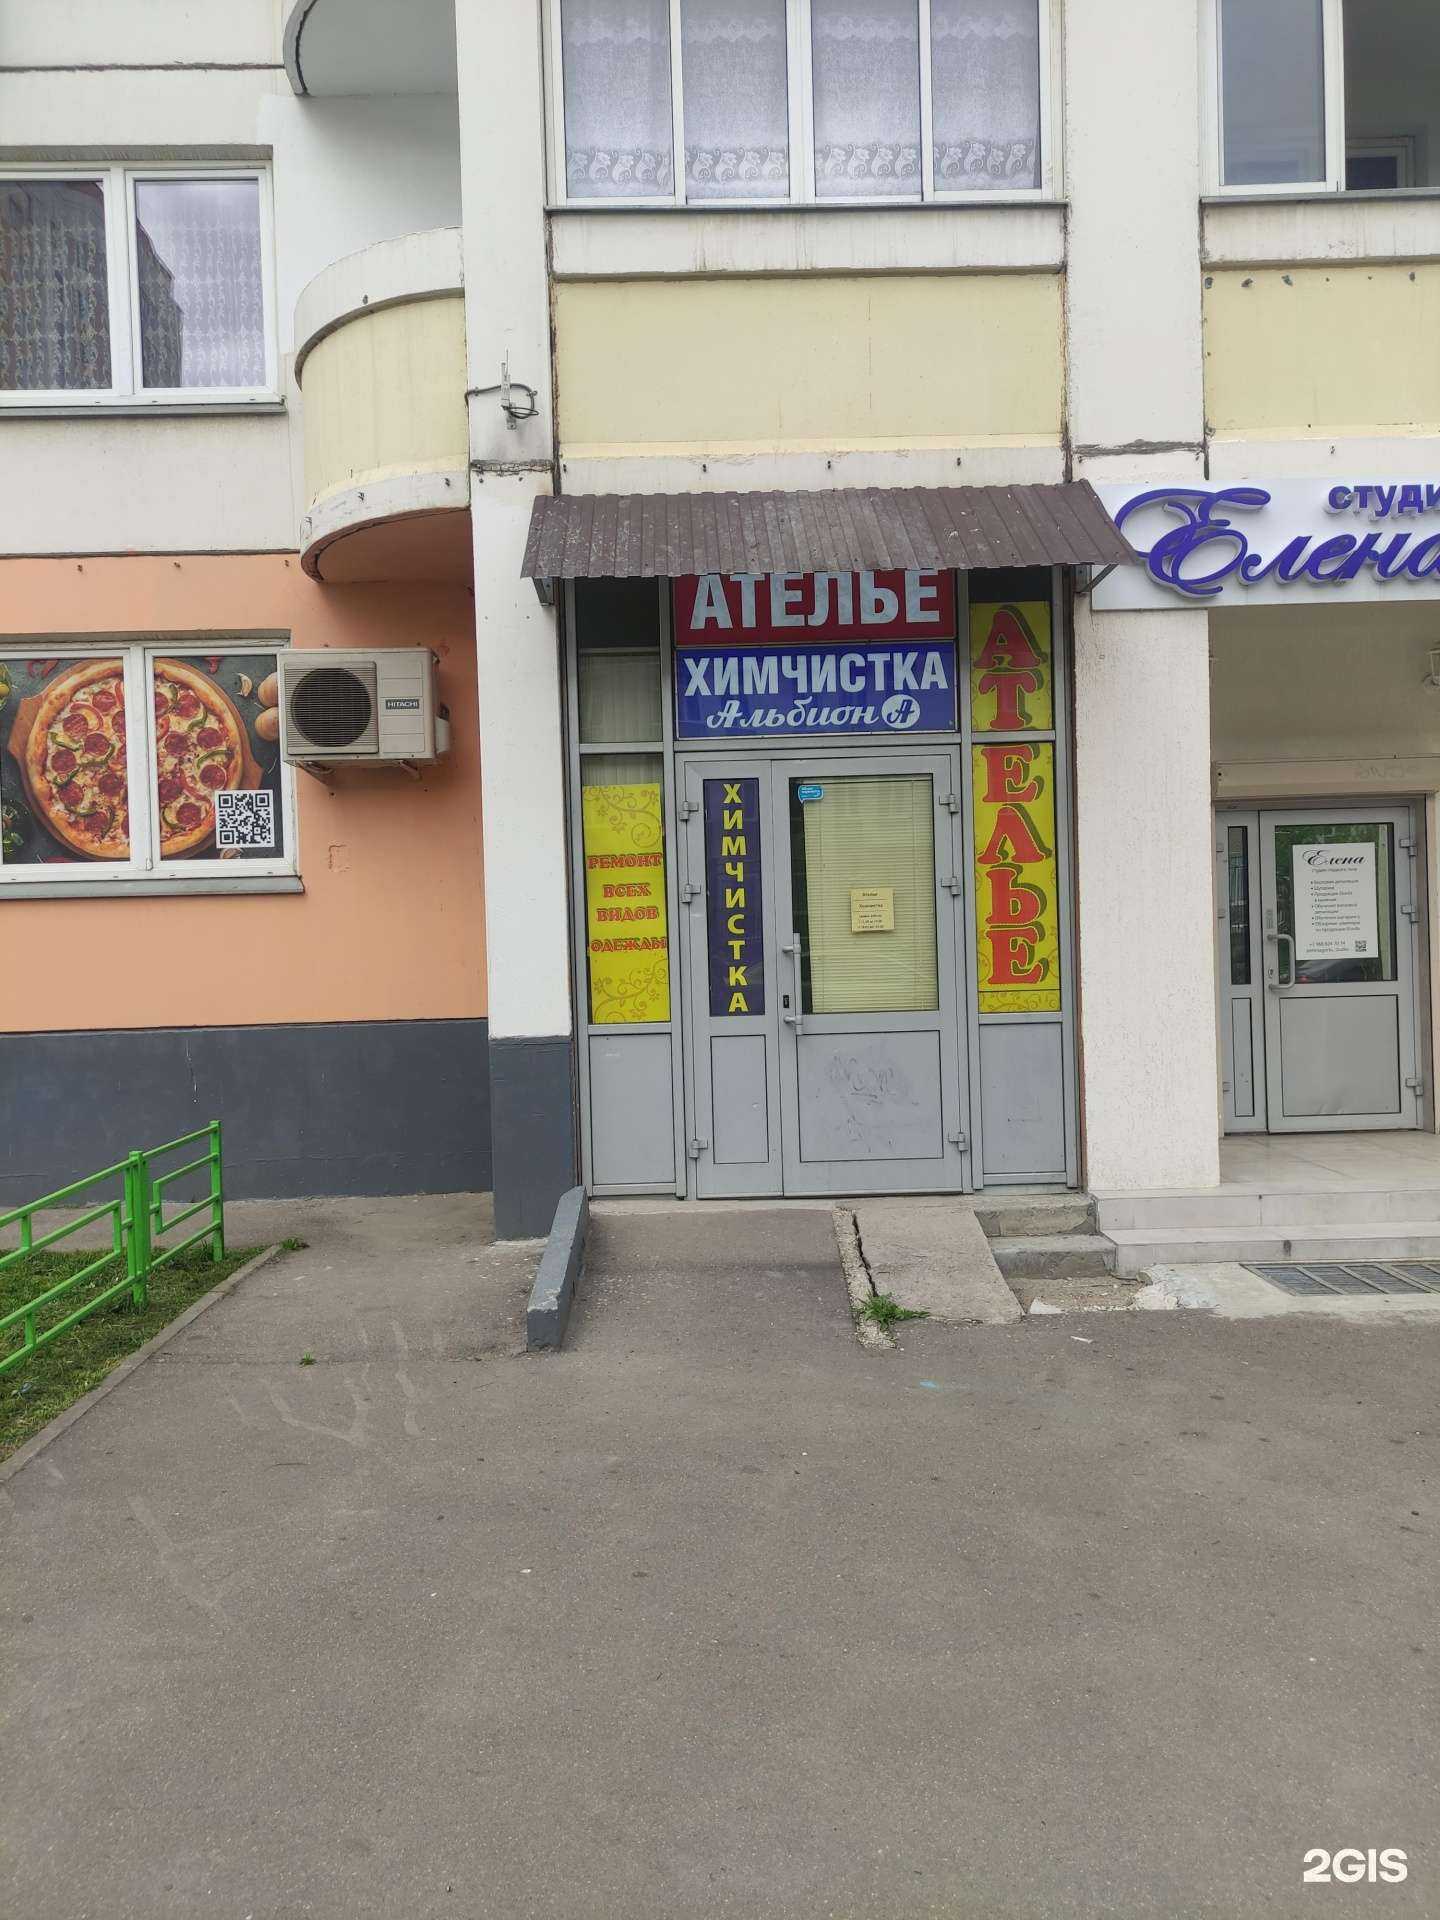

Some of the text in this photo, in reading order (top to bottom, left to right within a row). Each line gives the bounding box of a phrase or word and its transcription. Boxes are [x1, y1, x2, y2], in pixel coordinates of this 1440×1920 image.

[1114, 487, 1440, 595] Елена
[689, 570, 941, 630] АТЕЛЬЕ
[683, 651, 949, 697] ХИМЧИСТКА
[706, 696, 880, 729] Альбион
[974, 606, 1051, 985] АТЕЛЬЕ
[587, 853, 662, 869] РЕМОНТ
[602, 882, 652, 898] ВСЕХ
[721, 783, 749, 1013] ХИМЧИСТКА
[596, 906, 660, 922] ВИДОВ
[591, 936, 668, 952] ОДЕЖДЫ
